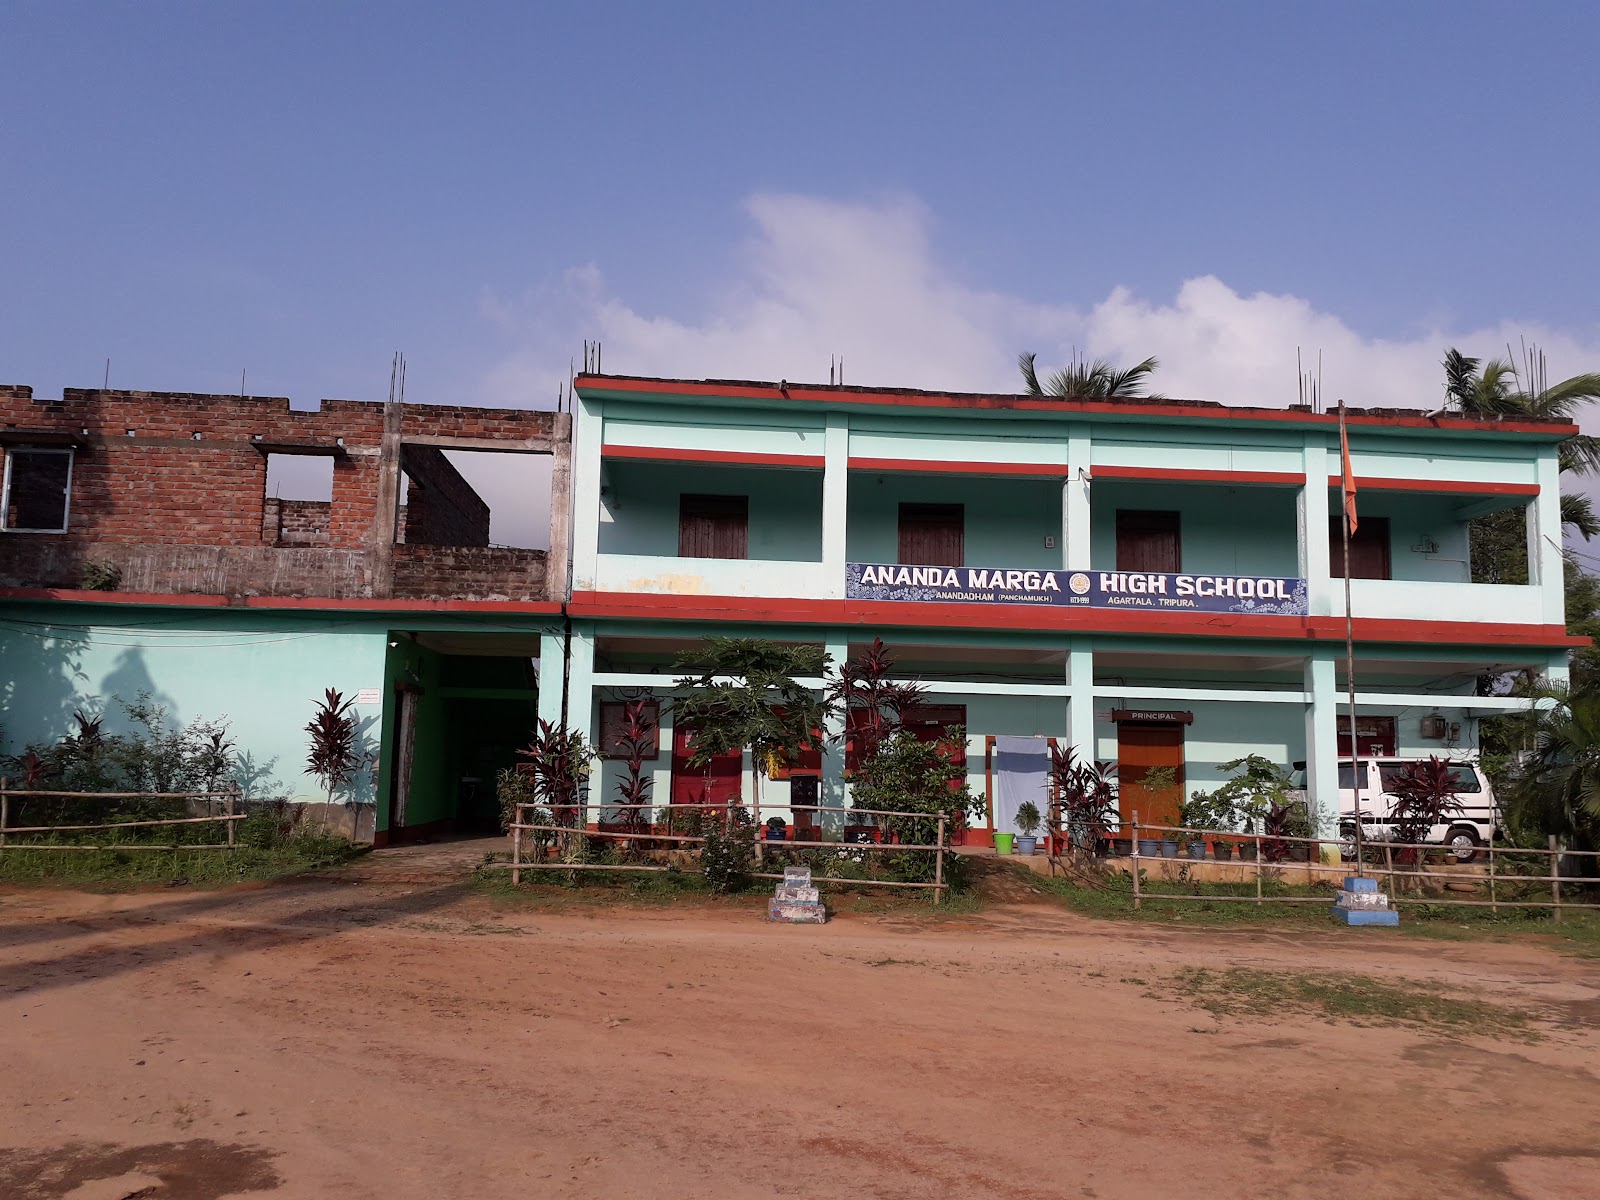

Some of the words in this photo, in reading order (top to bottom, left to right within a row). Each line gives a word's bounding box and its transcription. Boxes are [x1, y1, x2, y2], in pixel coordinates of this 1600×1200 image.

[860, 565, 961, 588] ANANDA
[968, 568, 1061, 592] MARGA
[1099, 573, 1167, 595] HIGH
[1175, 576, 1292, 600] SCHOOL
[935, 591, 994, 601] ANANDADHAM
[998, 593, 1053, 603] (PANCHAMUKH)
[1132, 712, 1176, 720] PRINCIPAL
